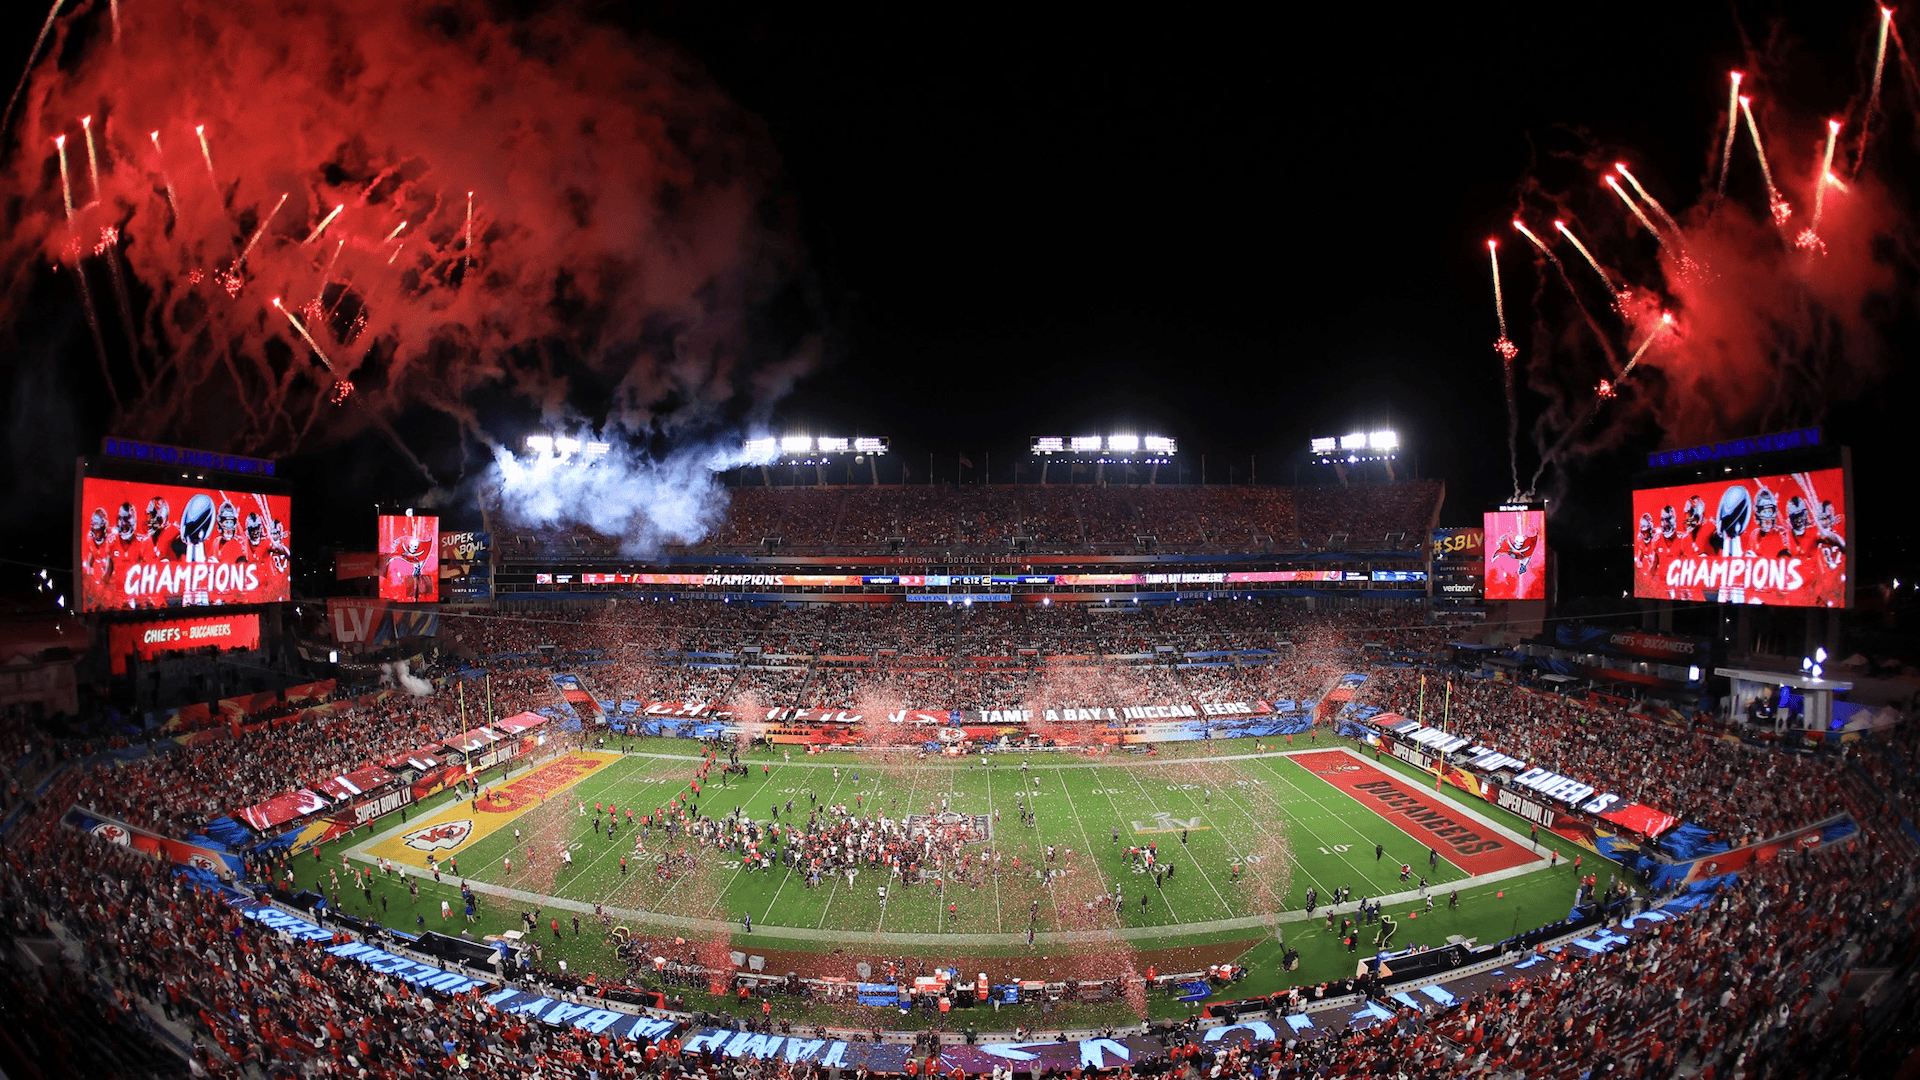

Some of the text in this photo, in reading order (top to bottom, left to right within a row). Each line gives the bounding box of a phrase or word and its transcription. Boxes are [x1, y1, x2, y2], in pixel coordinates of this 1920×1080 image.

[441, 532, 474, 548] SUPER
[459, 540, 487, 555] BOWL
[1433, 532, 1484, 554] #SBLV
[124, 563, 259, 596] CHAMPIONS
[703, 574, 783, 585] CHAMPIONS
[1145, 573, 1223, 584] TAMPA BAY BUCCANEERS
[1666, 558, 1804, 591] CHAMPIONS
[1442, 584, 1472, 592] verizon
[144, 628, 181, 643] CHIEFS
[189, 624, 231, 639] BUCCANEERS
[333, 608, 374, 642] LV
[1610, 634, 1636, 646] CHIEFS
[1642, 638, 1695, 654] BUCCANEERS
[1063, 707, 1102, 721] BAY
[1393, 741, 1410, 762] SUPER
[355, 799, 381, 824] SUPER
[380, 790, 403, 813] BOWL
[402, 786, 412, 805] LV
[1497, 789, 1555, 828] SUPER BOWL LV
[1350, 780, 1505, 857] BUCCANEERS
[1317, 844, 1347, 854] 10
